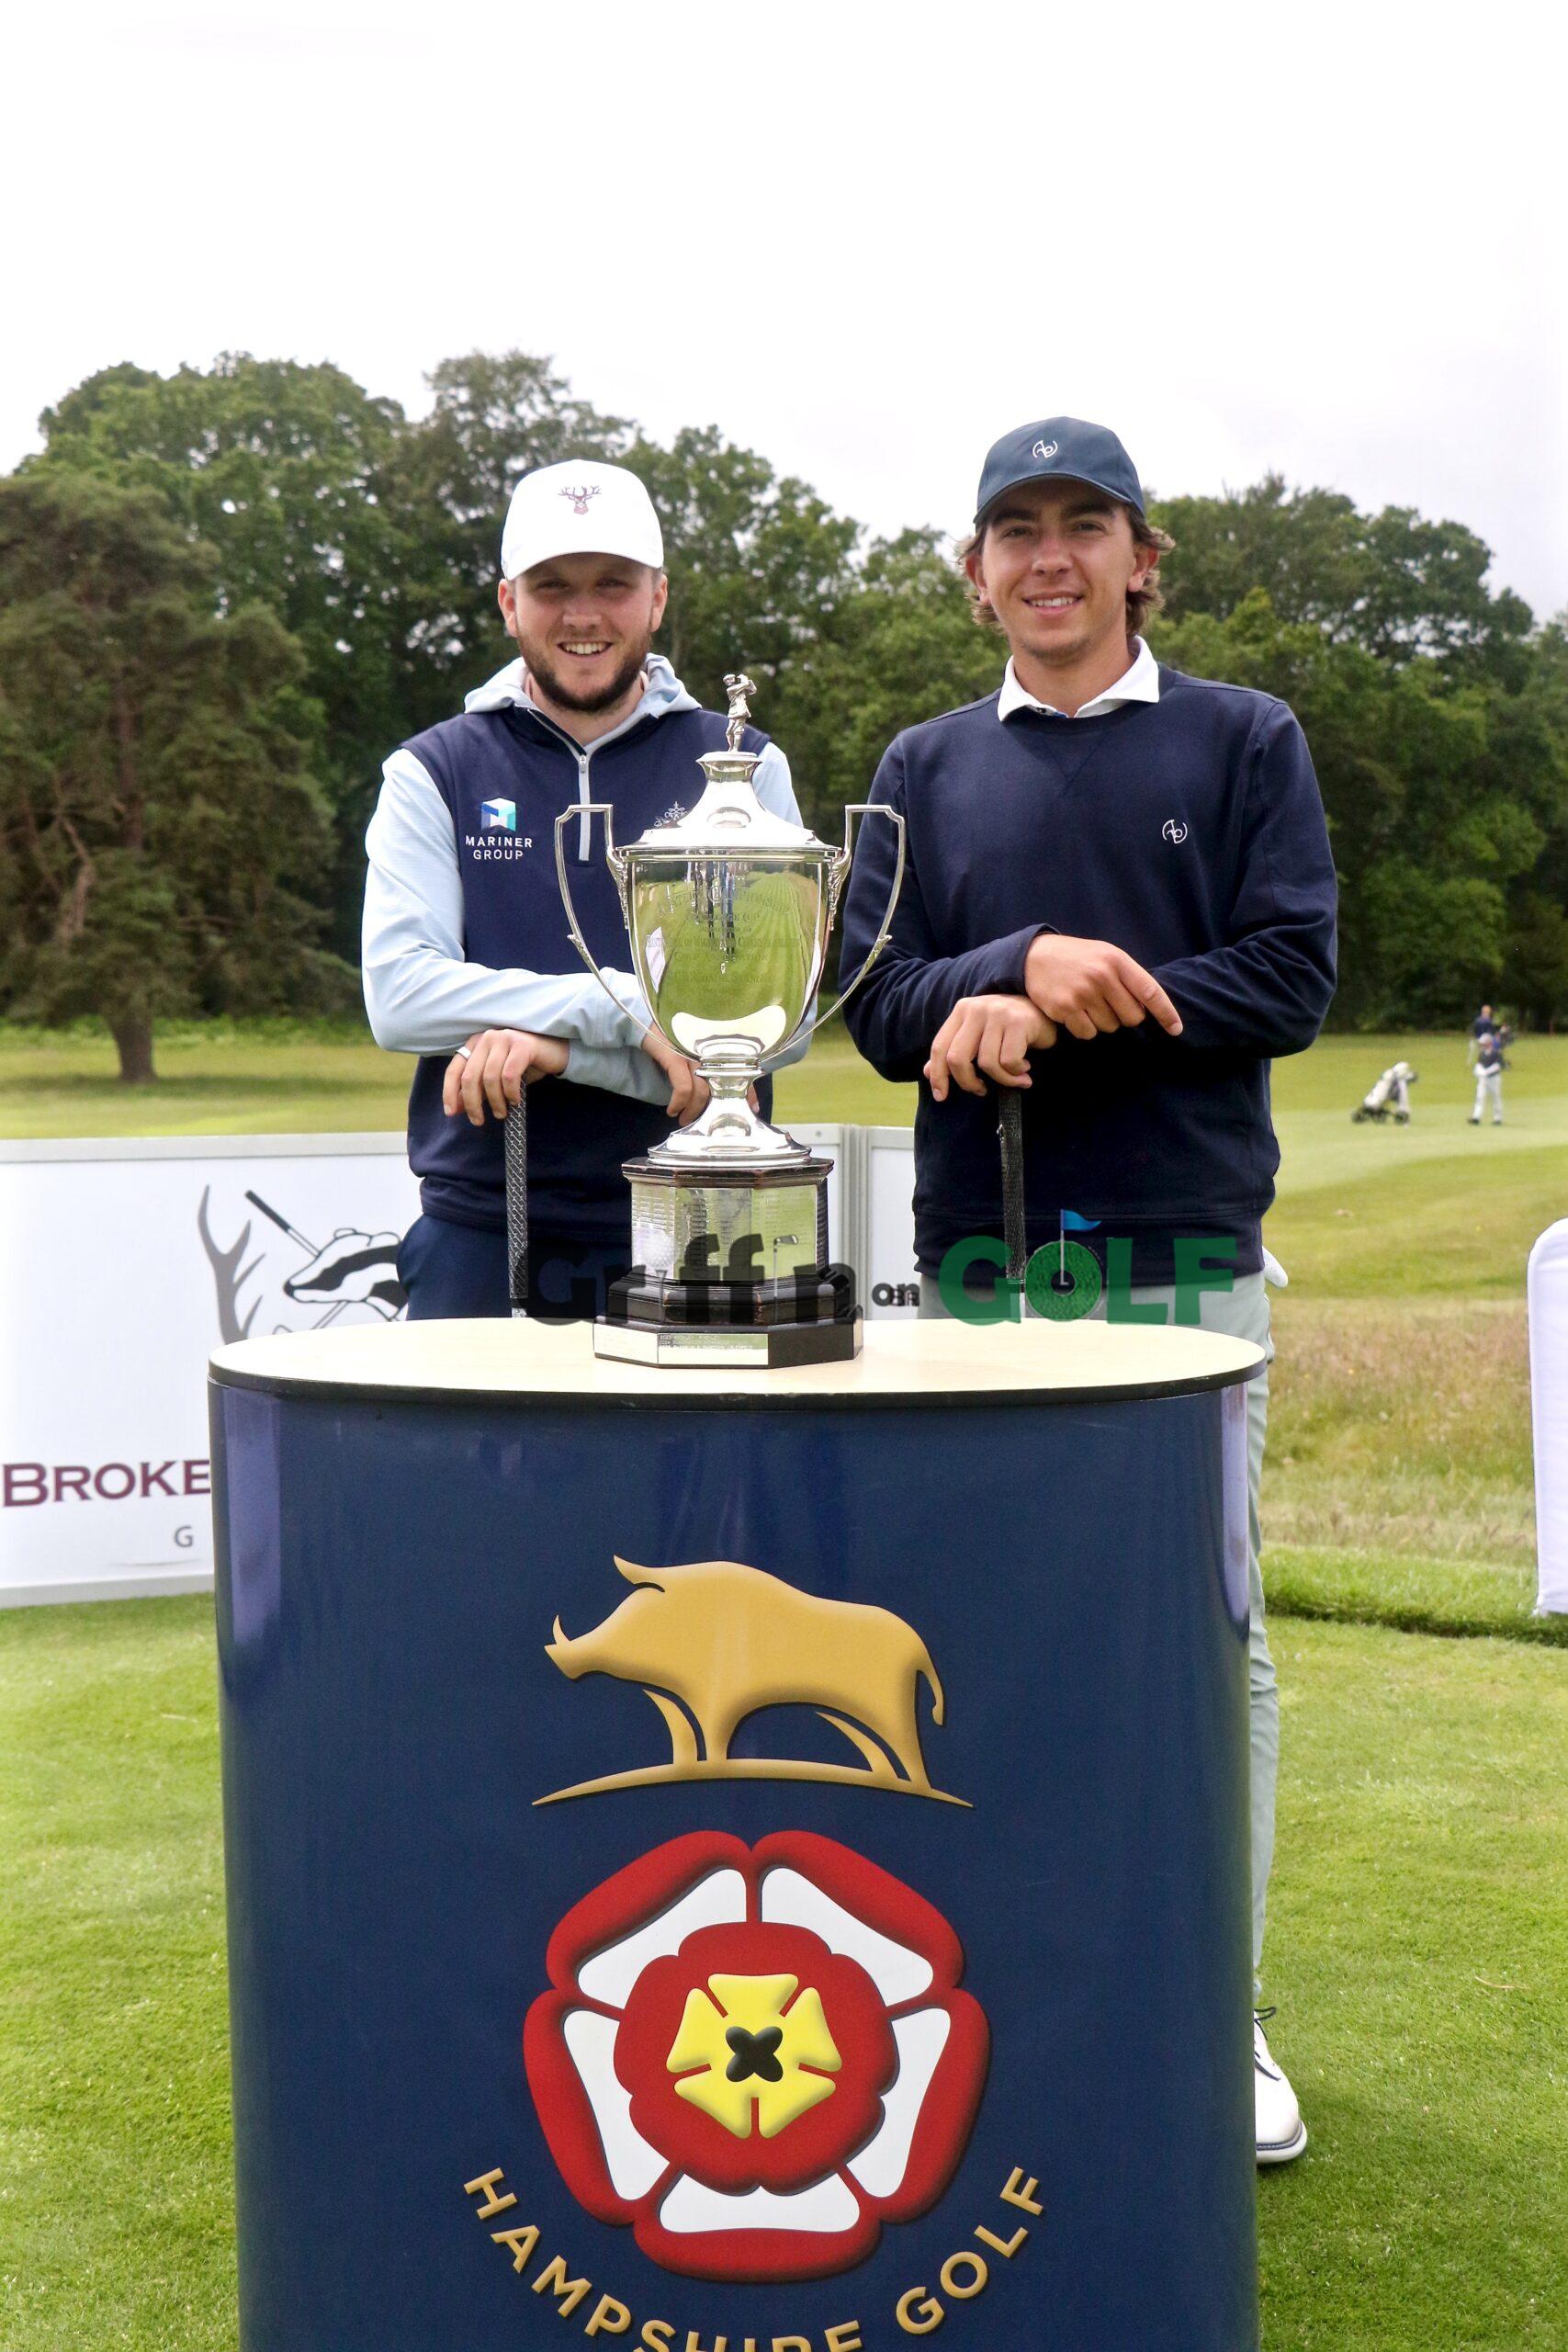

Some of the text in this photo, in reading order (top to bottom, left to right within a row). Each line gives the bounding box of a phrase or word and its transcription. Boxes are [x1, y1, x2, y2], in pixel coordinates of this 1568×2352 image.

[465, 835, 533, 848] MARINER
[473, 849, 524, 860] GROUP
[895, 2165, 1044, 2335] GOLF
